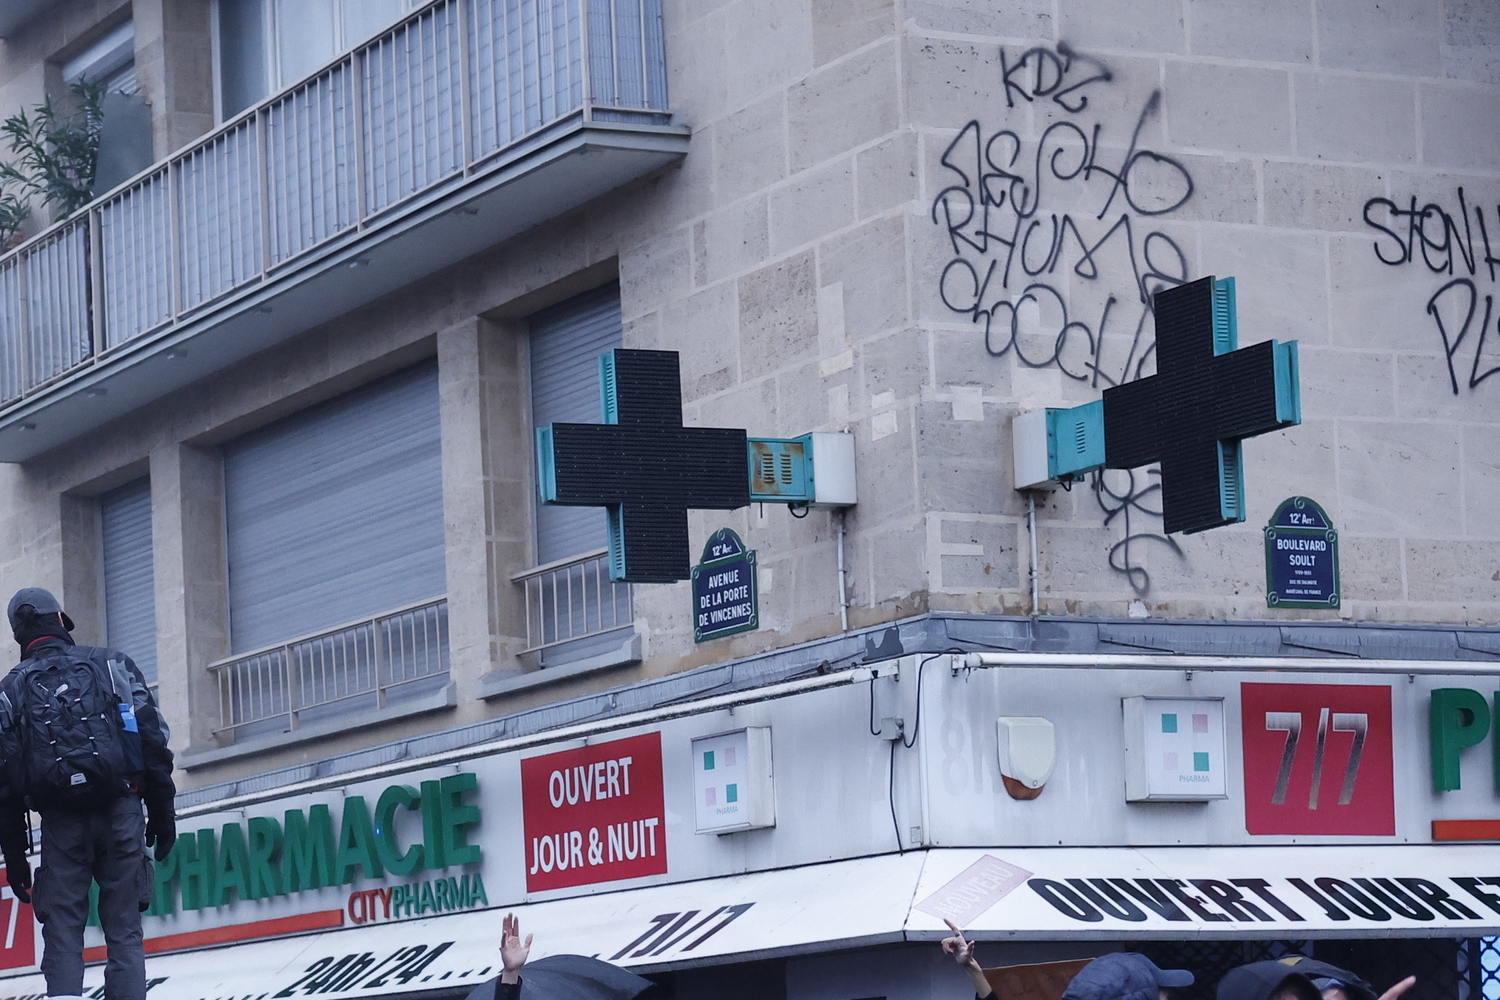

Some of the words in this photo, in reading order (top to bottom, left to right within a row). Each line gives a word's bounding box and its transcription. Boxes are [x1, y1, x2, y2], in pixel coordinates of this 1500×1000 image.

[1277, 539, 1327, 551] BOULEVARD
[1289, 555, 1316, 566] SOULT
[701, 594, 711, 609] DE
[712, 592, 723, 606] LA
[723, 585, 749, 603] PORTE
[708, 570, 740, 589] AVENUE
[699, 613, 709, 627] DE
[710, 602, 752, 625] VINCENNES
[1266, 707, 1368, 811] 7/7
[549, 757, 632, 808] OUVERT
[1179, 774, 1210, 783] PHARMA
[142, 772, 481, 916] PHARMACIE
[530, 831, 584, 875] JOUR
[588, 827, 603, 866] &
[608, 817, 659, 862] NUIT
[1026, 877, 1307, 923] OUVERT
[1285, 877, 1483, 922] JOUR
[271, 941, 456, 1000] 24h/24
